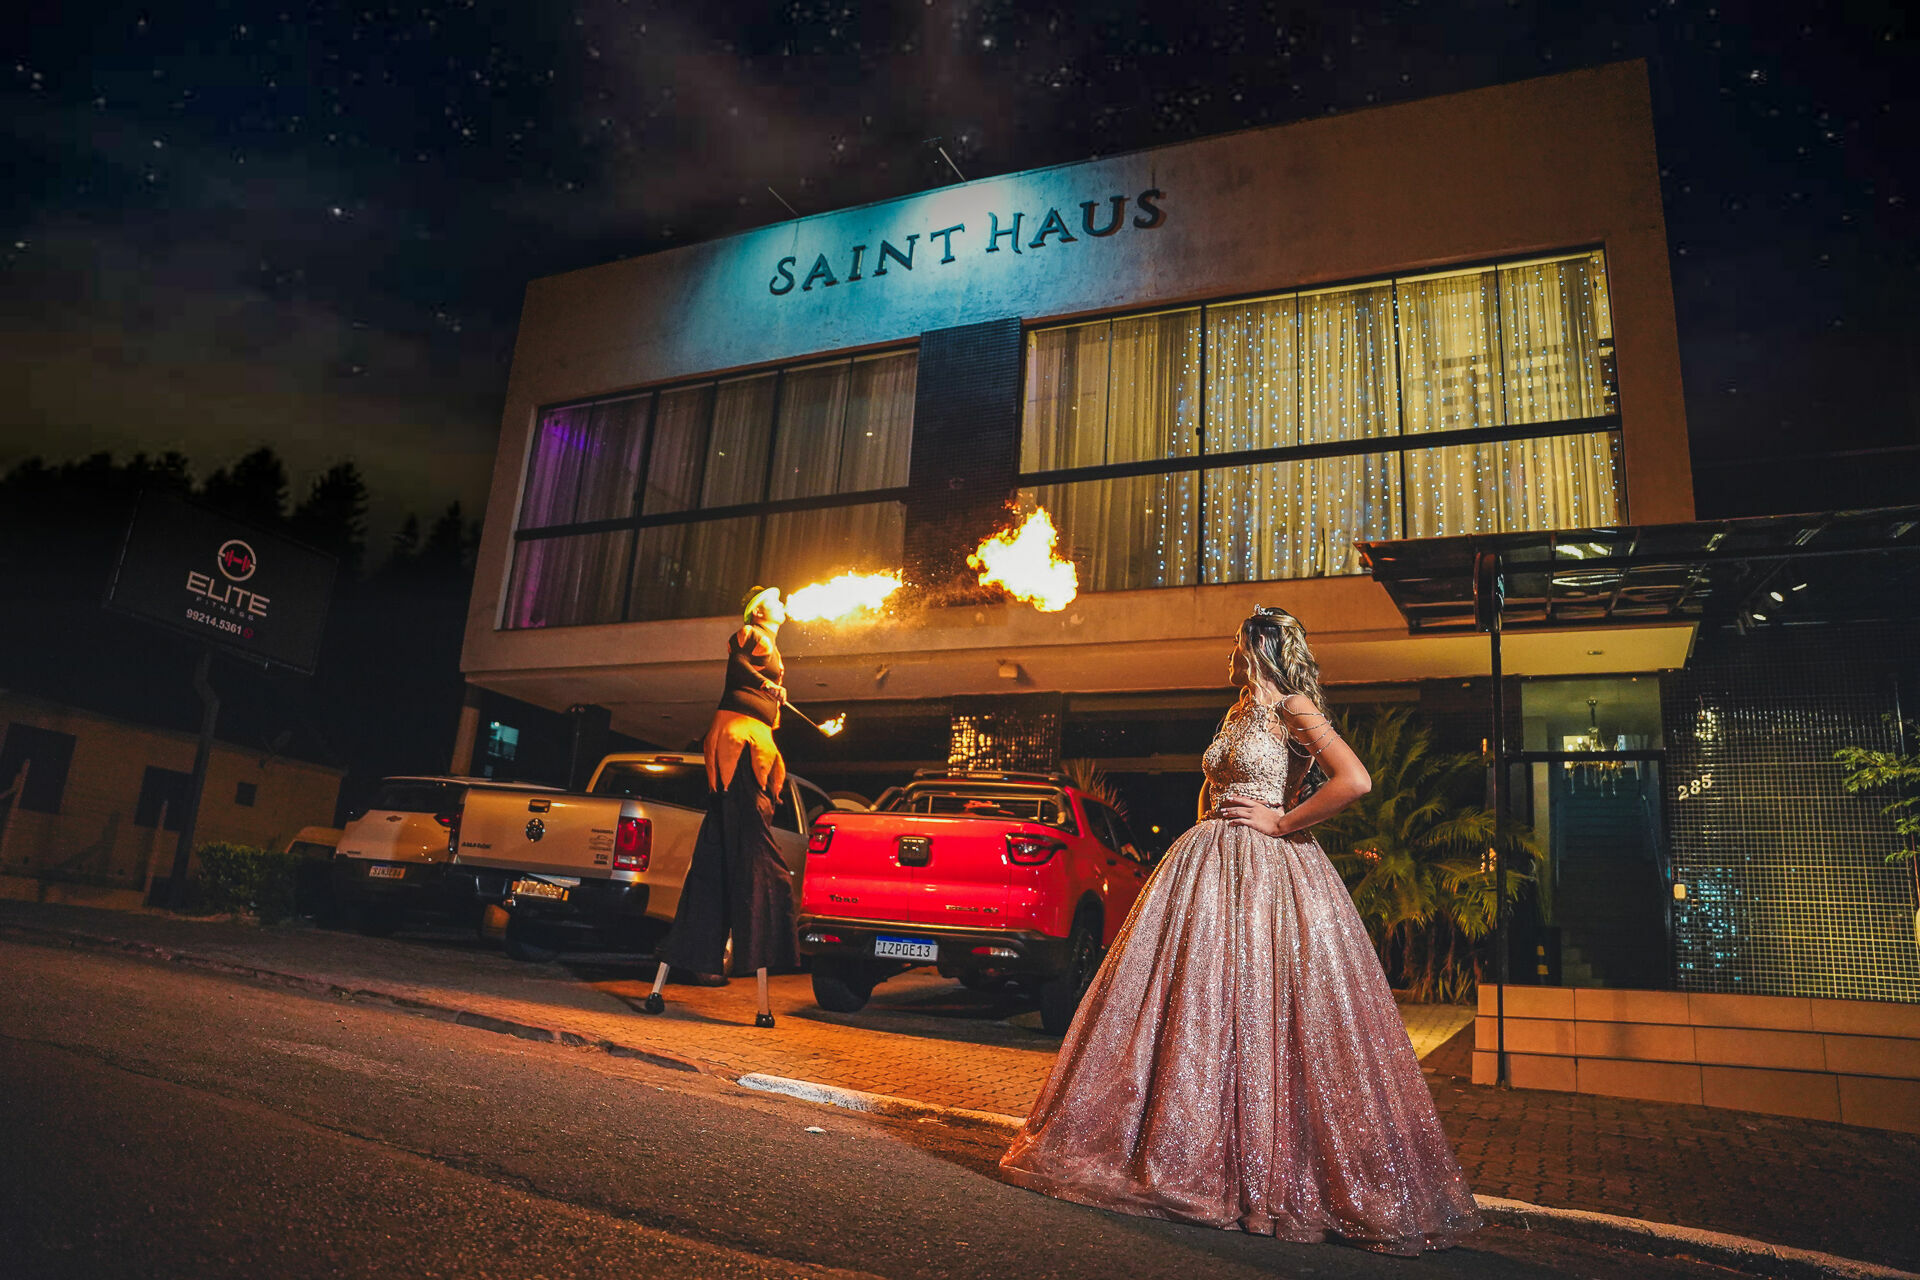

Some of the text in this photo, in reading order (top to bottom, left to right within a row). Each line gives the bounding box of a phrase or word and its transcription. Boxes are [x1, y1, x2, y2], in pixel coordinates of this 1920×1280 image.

[769, 190, 1167, 296] SAINT HAUS
[187, 571, 270, 616] ELITE
[186, 608, 242, 635] 99214.5361
[196, 596, 254, 621] FITNESS
[1677, 773, 1712, 801] 285
